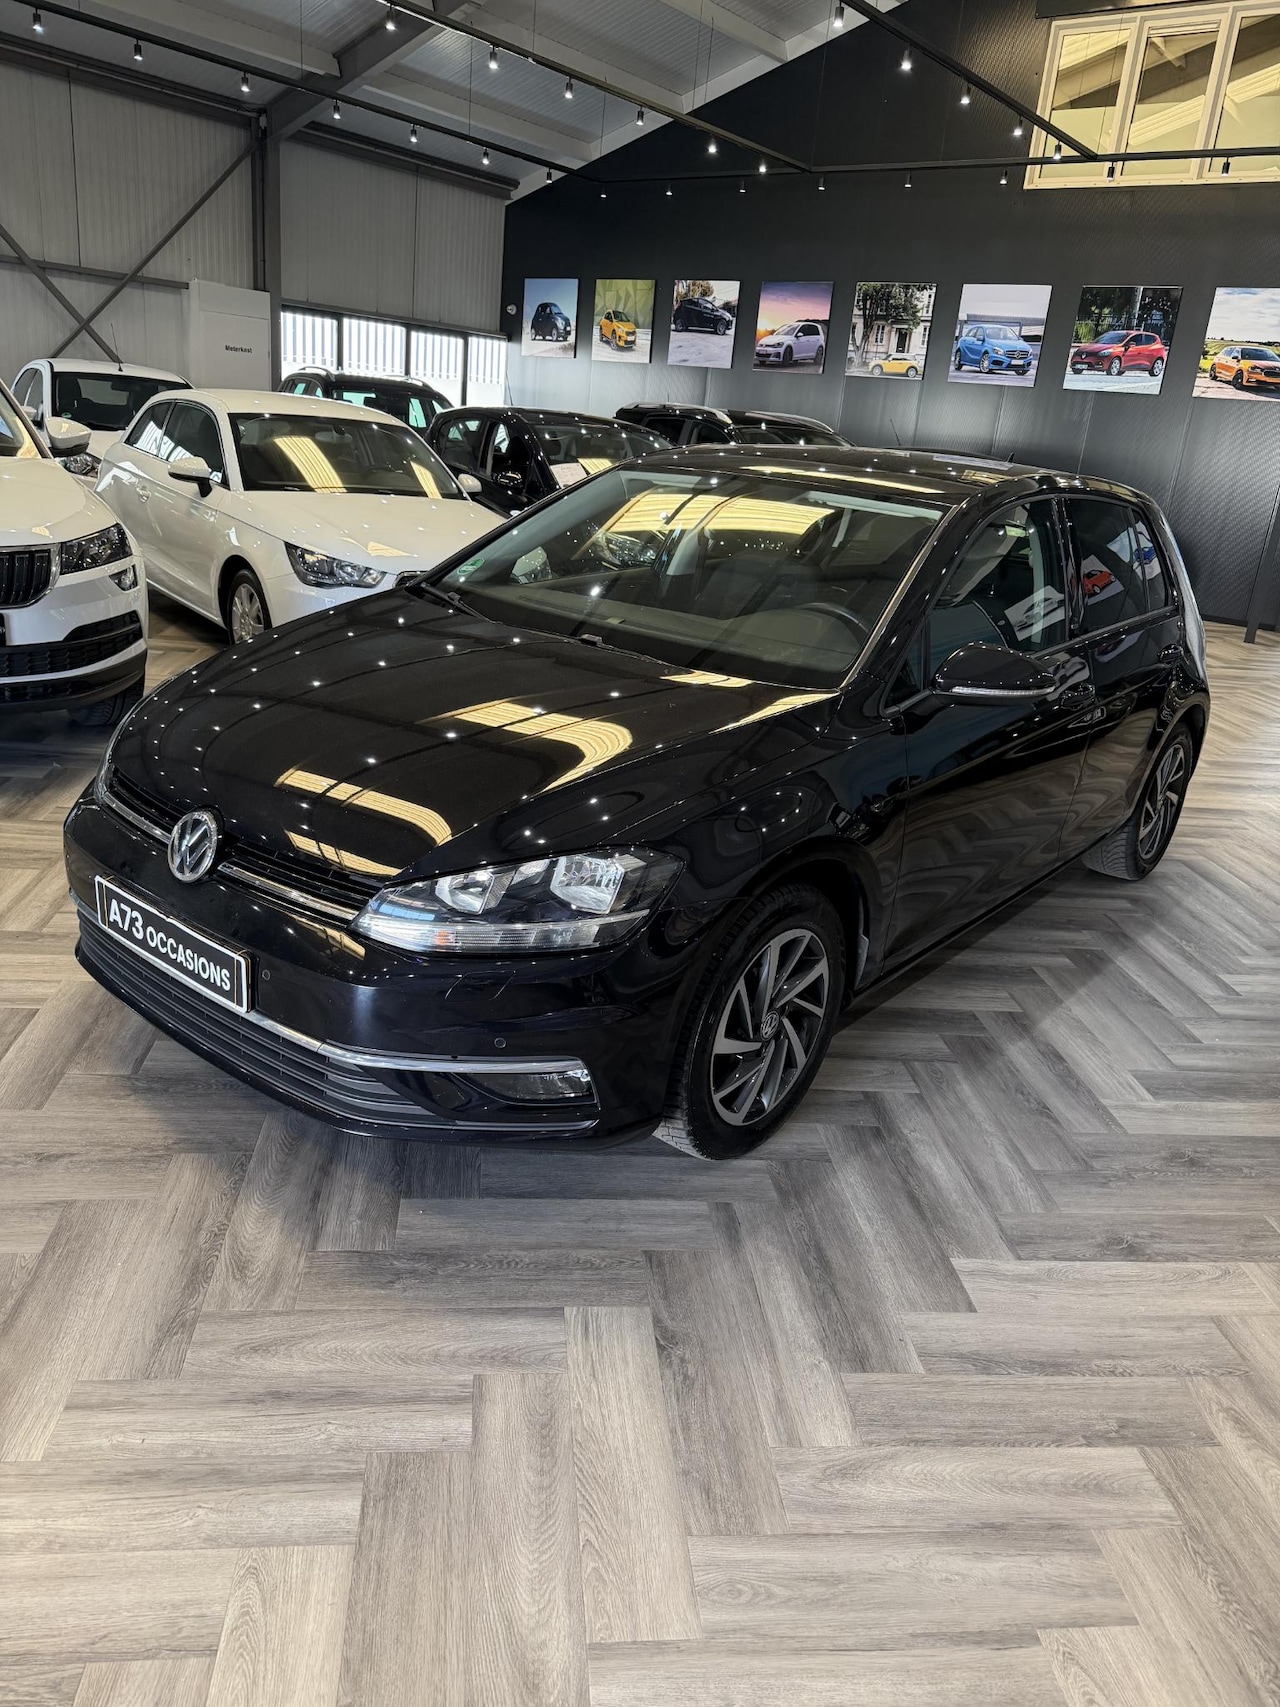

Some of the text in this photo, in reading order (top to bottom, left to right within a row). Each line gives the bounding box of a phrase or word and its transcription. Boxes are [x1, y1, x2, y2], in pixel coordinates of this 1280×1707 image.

[224, 344, 253, 354] Meterkast
[109, 898, 231, 991] A73 OCCASIONS
